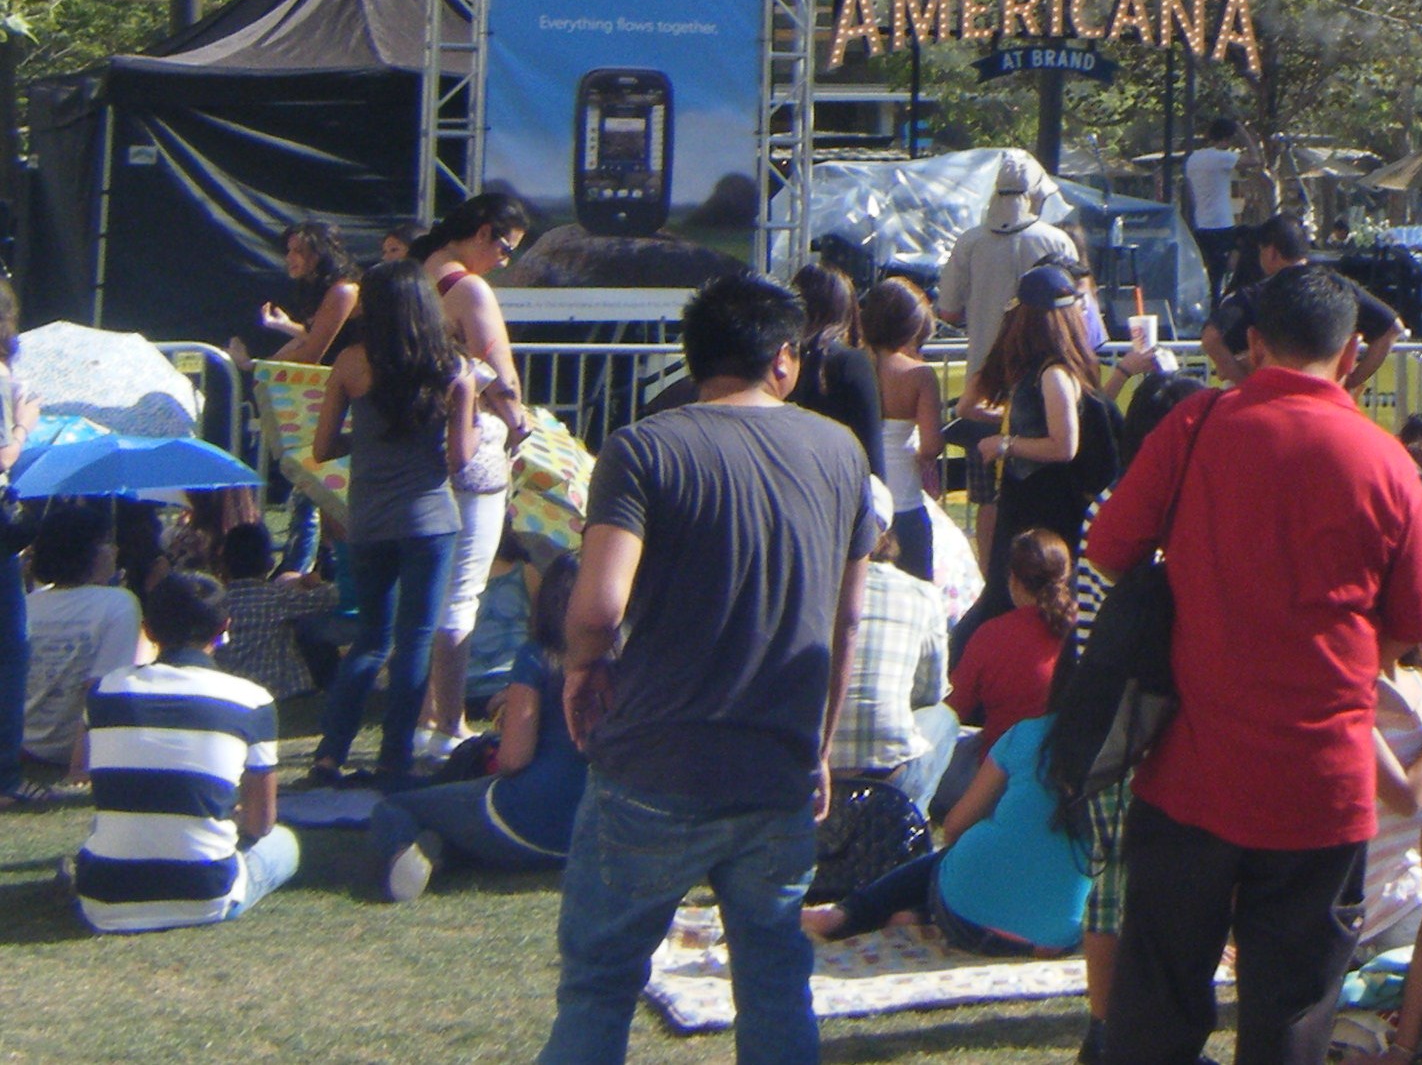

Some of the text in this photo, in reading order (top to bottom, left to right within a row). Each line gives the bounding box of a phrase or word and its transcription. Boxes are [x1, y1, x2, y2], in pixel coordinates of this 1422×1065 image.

[539, 14, 613, 34] Everything
[617, 17, 654, 32] flows
[1001, 48, 1096, 71] AT BRAND
